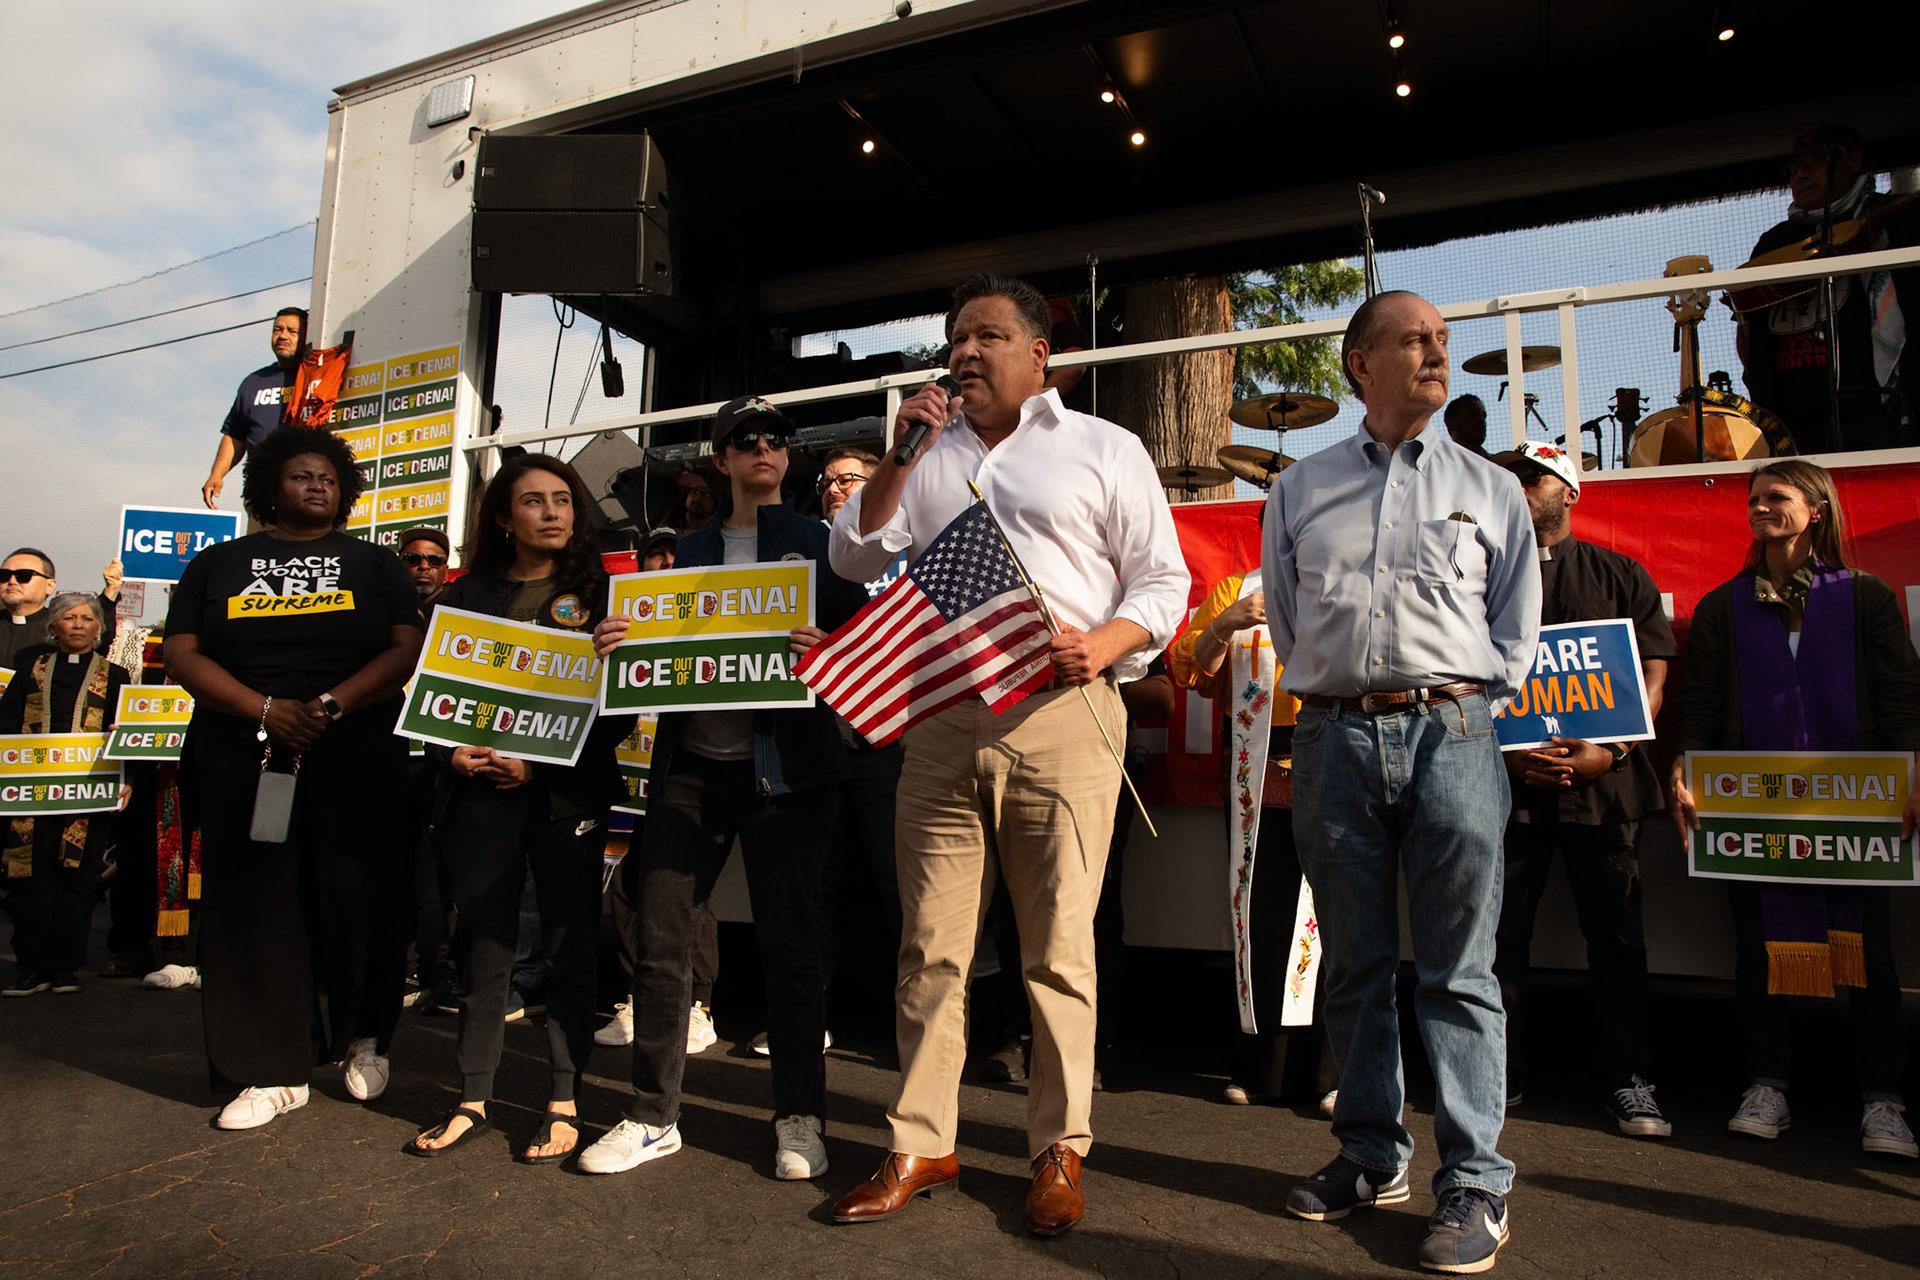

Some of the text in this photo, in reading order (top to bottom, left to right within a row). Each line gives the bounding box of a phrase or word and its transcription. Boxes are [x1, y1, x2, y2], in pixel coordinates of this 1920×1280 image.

[389, 364, 411, 380] ICE
[418, 354, 456, 375] DENA!
[254, 387, 282, 406] ICE
[387, 395, 409, 412] ICE
[416, 386, 454, 407] DENA!
[343, 401, 379, 421] DENA!
[385, 430, 406, 447] ICE
[413, 421, 451, 441] DENA!
[348, 436, 376, 453] ENA!
[382, 462, 404, 479] ICE
[411, 454, 449, 475] DENA!
[380, 497, 401, 514] ICE
[409, 490, 447, 510] DENA!
[124, 529, 173, 554] ICE
[175, 532, 192, 543] OUT
[378, 529, 399, 546] ICE
[177, 543, 188, 555] OF
[251, 556, 341, 570] BLACK
[251, 567, 341, 578] WOMEN
[238, 576, 339, 597] ARE
[240, 593, 346, 611] SUPREME
[622, 585, 798, 623] ICE OUT OF DENA!
[437, 630, 600, 683] ICE OUT OF DENA!
[1535, 636, 1602, 675] ARE
[618, 652, 797, 689] ICE OUT OF DENA!
[127, 698, 161, 713] ICE
[162, 698, 175, 706] OUT
[419, 690, 580, 742] ICE OUT OF DENA!
[118, 732, 155, 748] ICE
[154, 740, 164, 748] OF
[155, 733, 168, 741] OUT
[0, 746, 105, 765] CE OUT OF DENA
[0, 782, 114, 802] CE OUT OF DENA!
[1703, 772, 1897, 801] ICE OUT OF DENA!
[1705, 831, 1900, 863] ICE OUT OF DENA!
